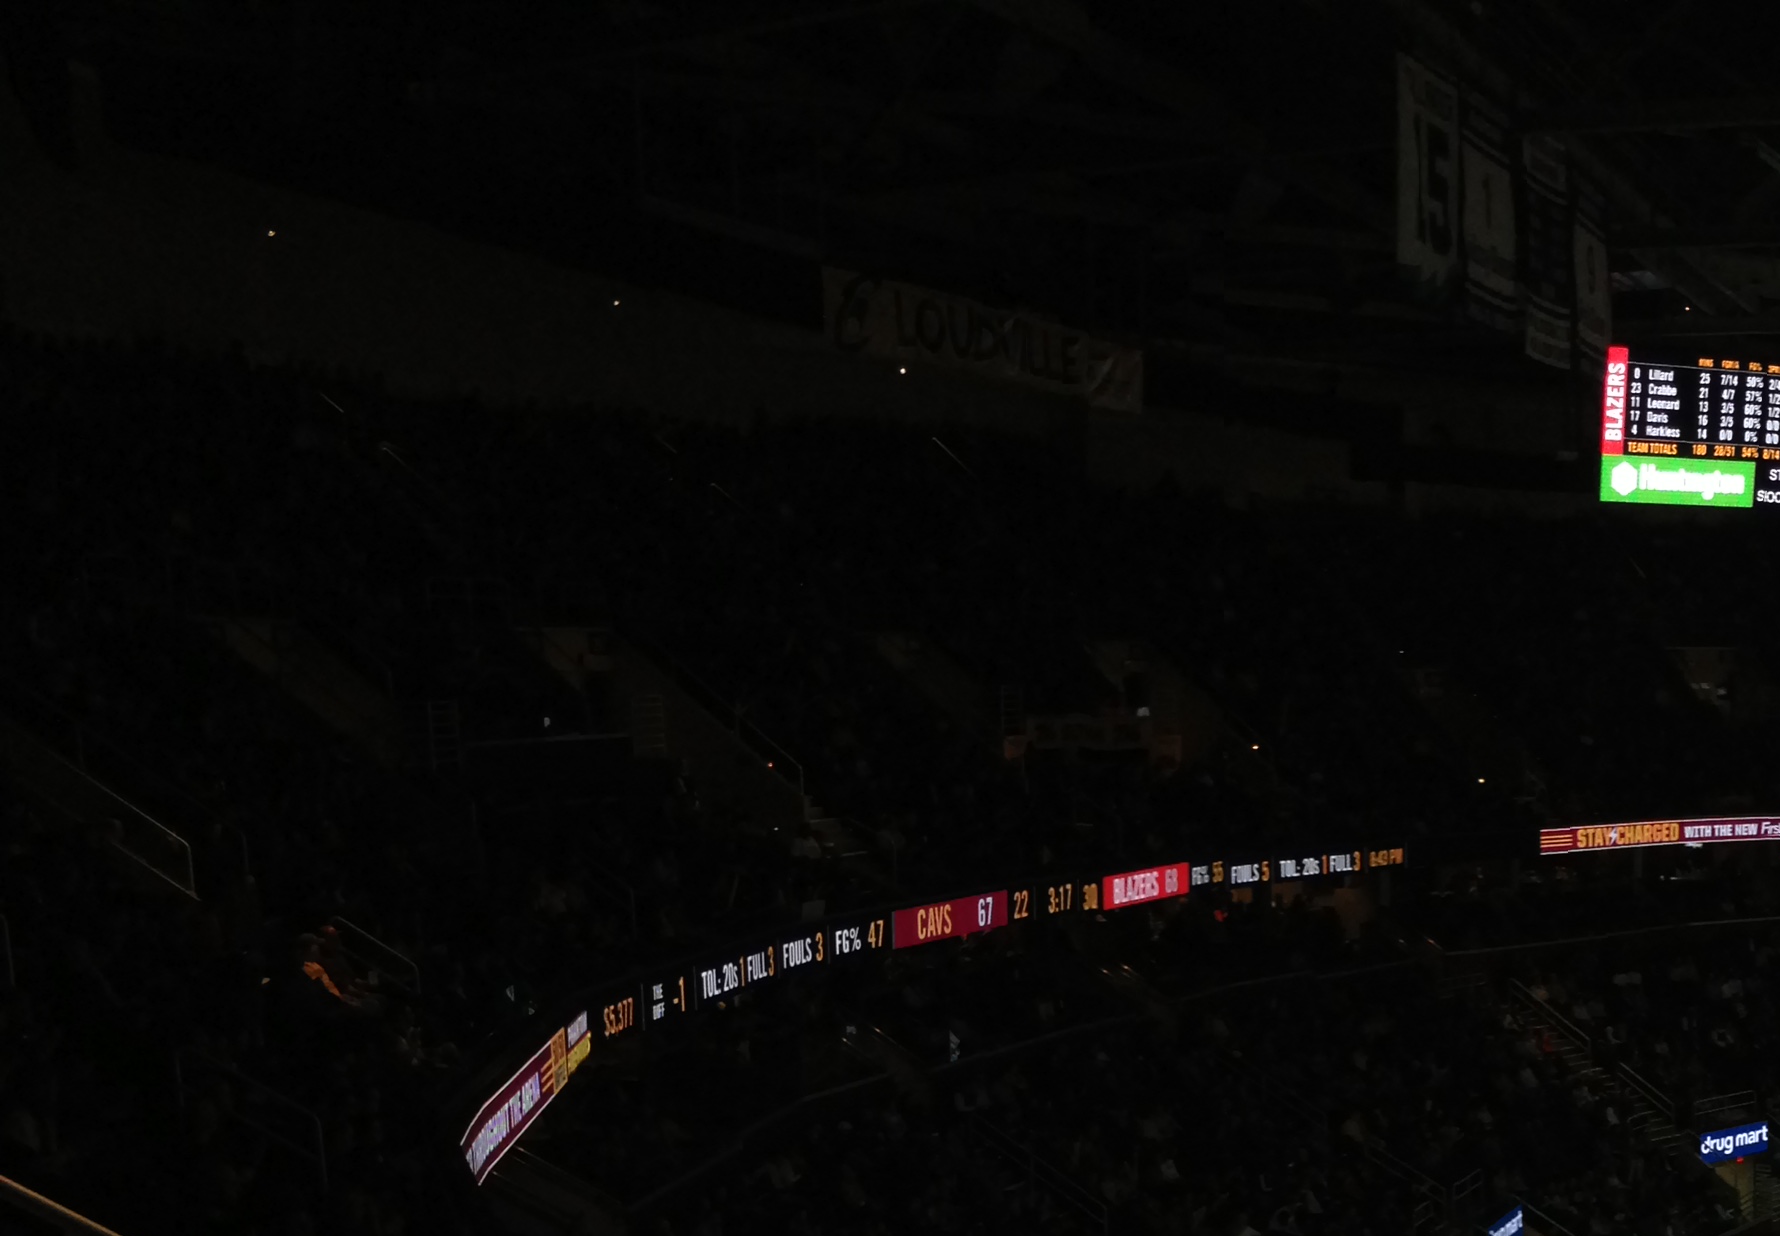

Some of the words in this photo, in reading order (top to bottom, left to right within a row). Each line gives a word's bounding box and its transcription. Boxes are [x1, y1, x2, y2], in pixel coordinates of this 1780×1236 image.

[1631, 383, 1641, 394] 23
[1649, 369, 1674, 381] Lillard
[1700, 373, 1711, 384] 25
[1605, 363, 1626, 441] BLAZERS
[1639, 463, 1745, 500] Huntington
[1577, 826, 1611, 848] STAY
[1616, 822, 1680, 846] CHARGED
[1713, 824, 1733, 837] THE
[1735, 822, 1758, 837] NEW
[1113, 871, 1160, 905] BLAZERS
[1164, 867, 1179, 893] 68
[1231, 863, 1260, 885] FOULS
[1261, 861, 1270, 882] 5
[1014, 889, 1029, 920] 22
[1048, 883, 1073, 914] 3:17
[917, 903, 952, 940] CAVS
[977, 896, 994, 927] 67
[783, 937, 812, 969] FOULS
[815, 932, 824, 962] 3
[835, 926, 861, 955] FG%
[867, 920, 884, 949] 47
[701, 968, 722, 999] TOL:
[723, 962, 739, 992] 20s
[739, 956, 746, 987] 1
[747, 950, 768, 982] FULL
[768, 945, 775, 977] 3
[603, 996, 634, 1039] $5,377
[1700, 1136, 1734, 1155] drug
[1735, 1124, 1769, 1147] mart
